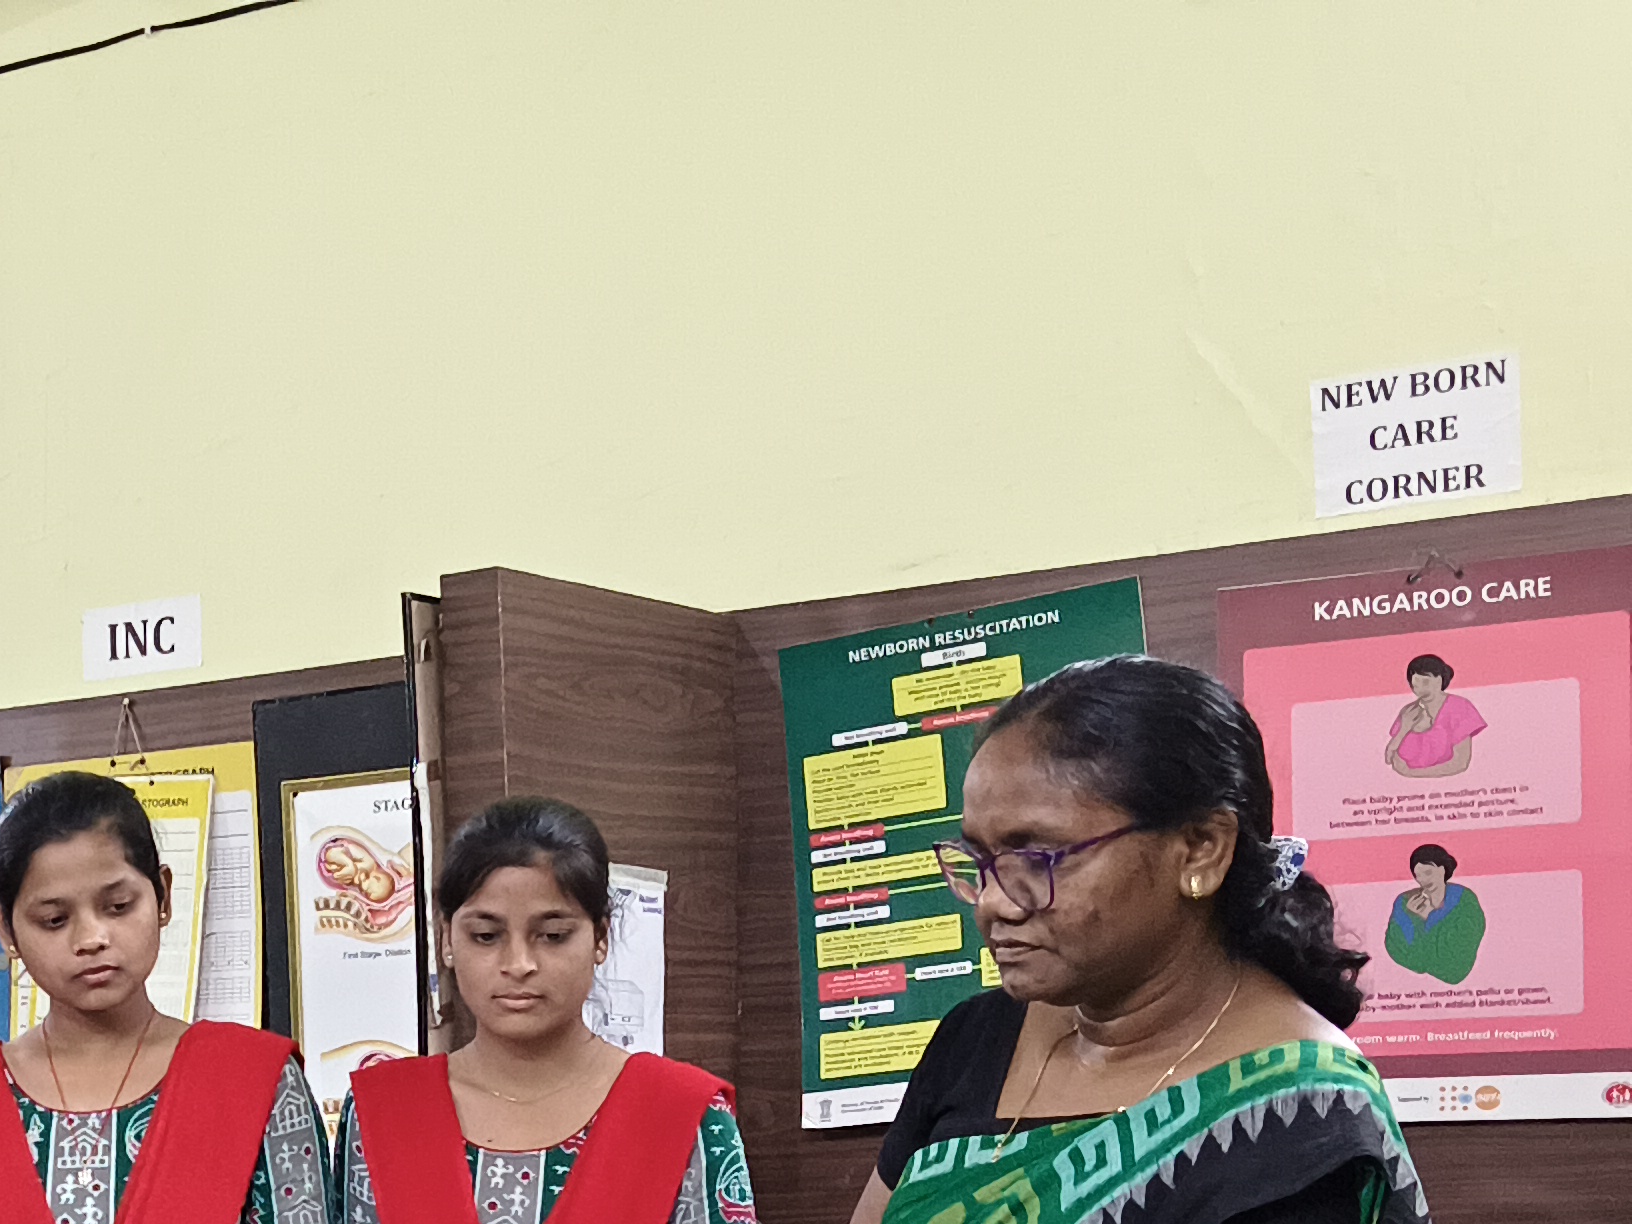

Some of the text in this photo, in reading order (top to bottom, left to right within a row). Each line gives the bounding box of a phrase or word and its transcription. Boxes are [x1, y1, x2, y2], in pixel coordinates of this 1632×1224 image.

[1319, 358, 1507, 412] NEW BORN
[1369, 414, 1458, 451] CARE
[1345, 463, 1486, 505] CORNER
[1313, 574, 1552, 621] KANGAROO CARE
[108, 616, 175, 661] INC
[848, 609, 1060, 663] NEWBORN RESUSCITATION
[1427, 1029, 1490, 1042] Breastfeed
